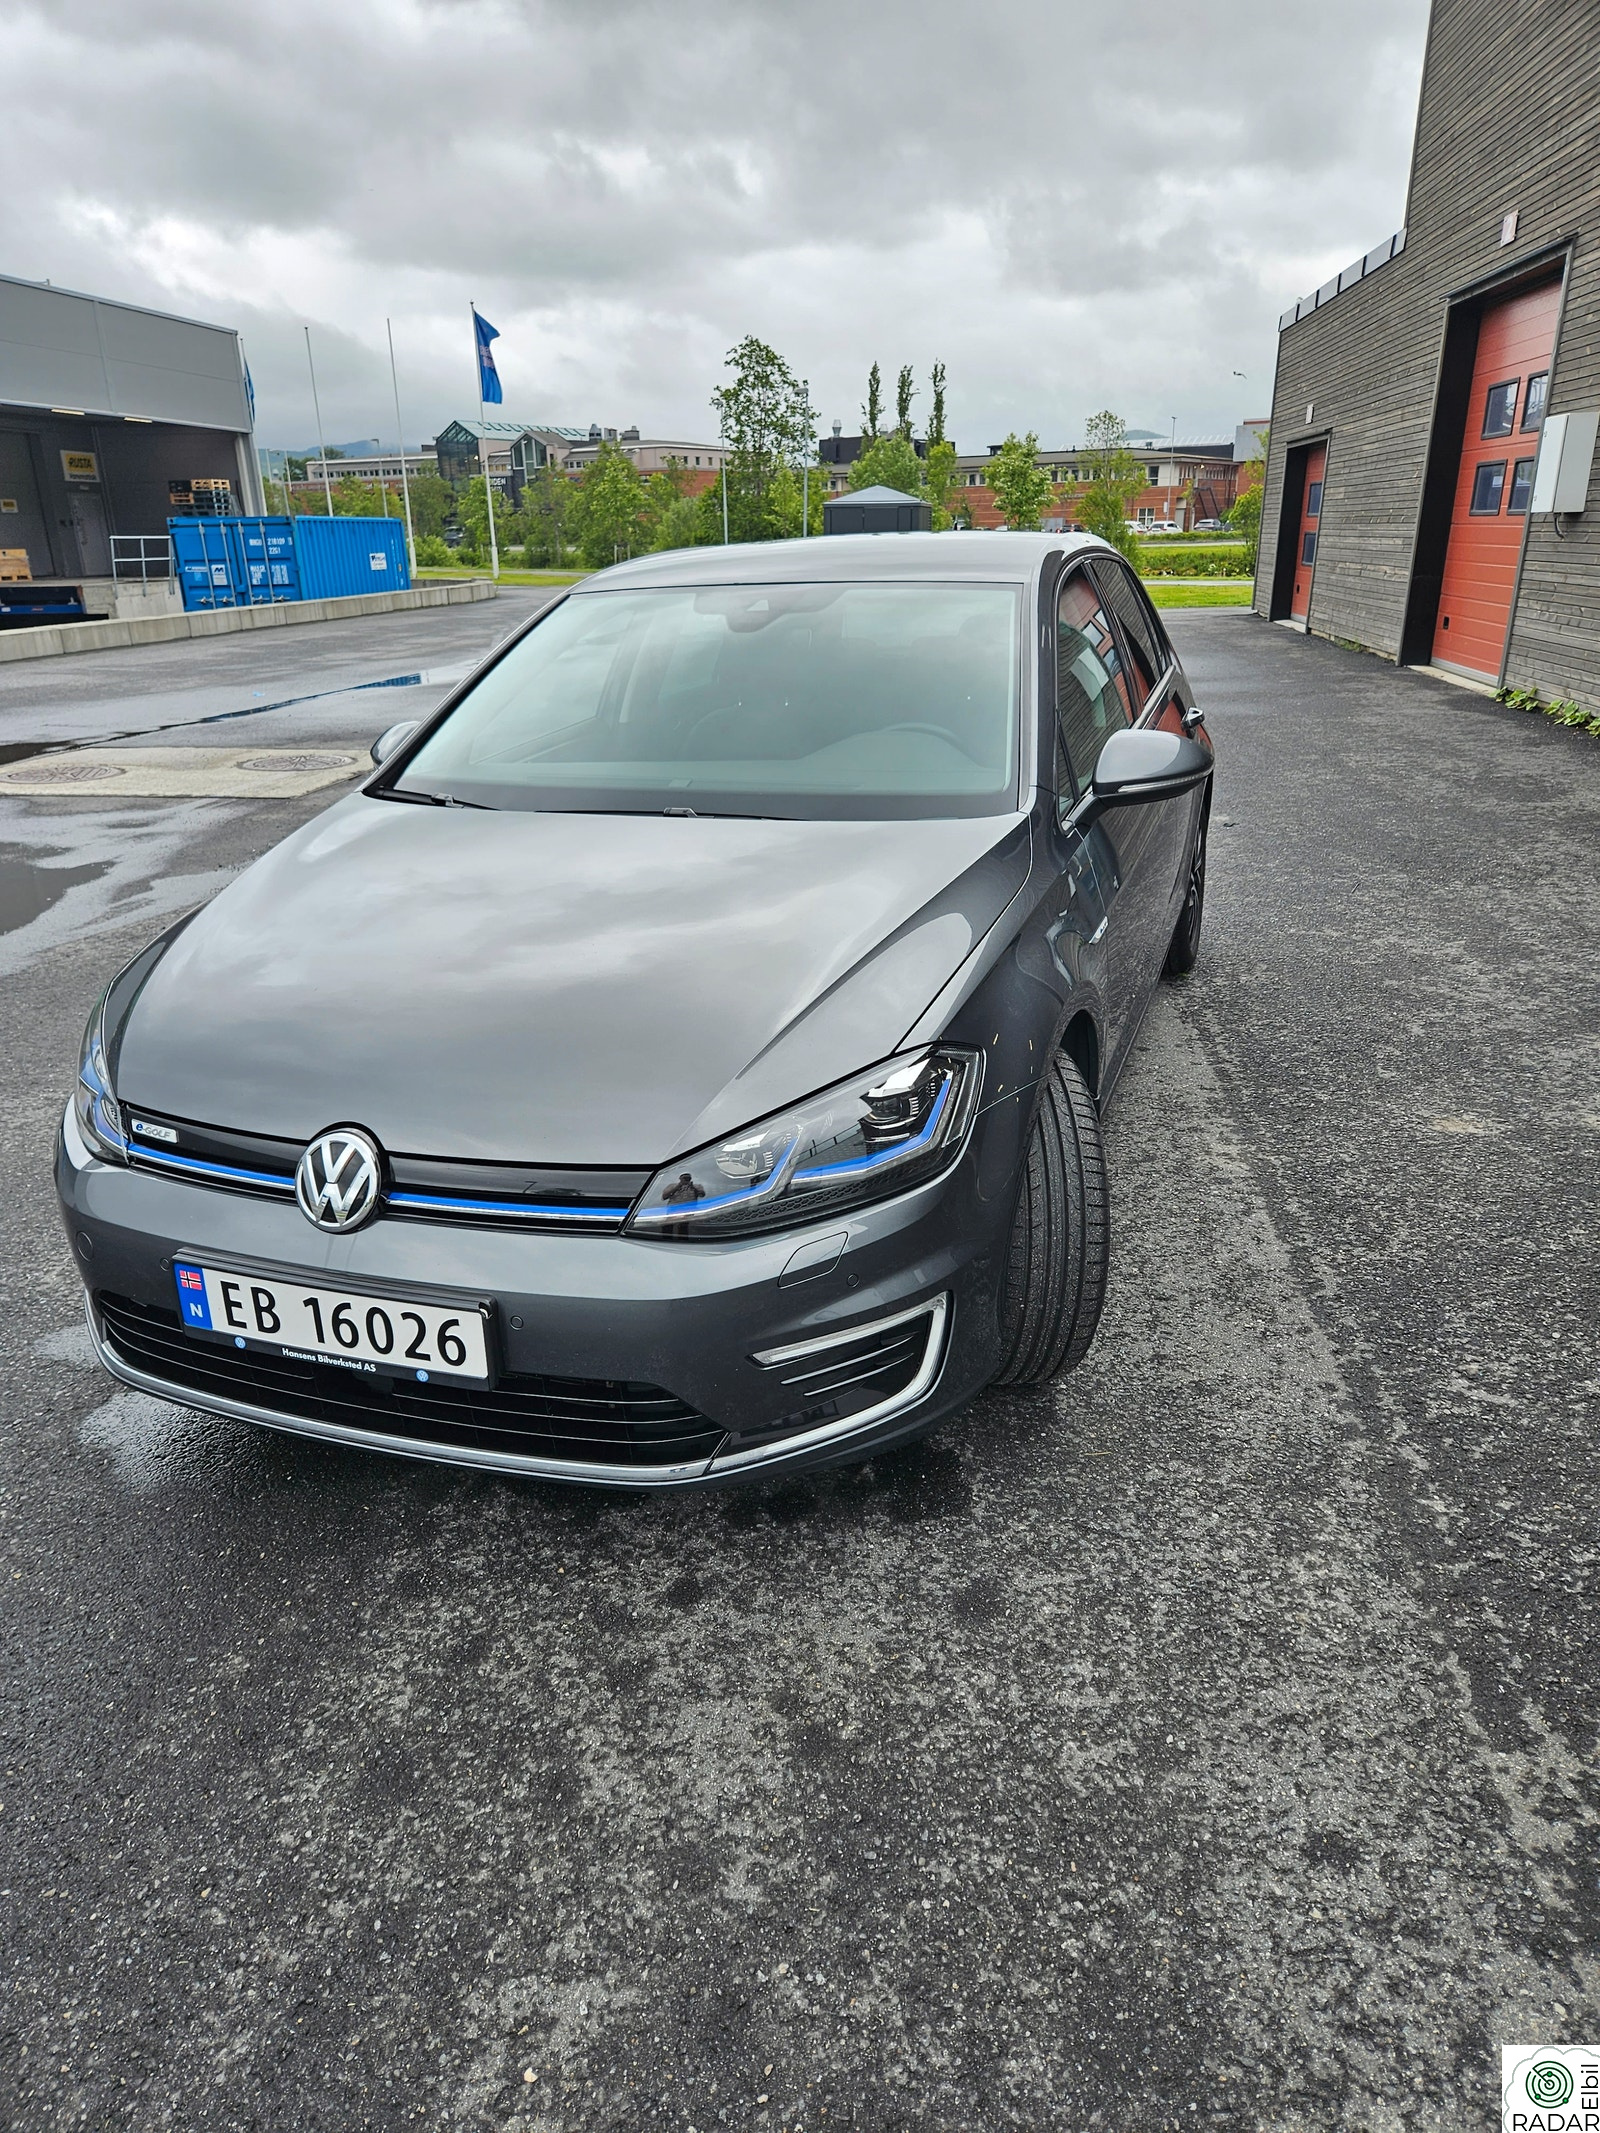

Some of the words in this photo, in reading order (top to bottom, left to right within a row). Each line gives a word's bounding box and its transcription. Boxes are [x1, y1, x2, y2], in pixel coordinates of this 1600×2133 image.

[68, 456, 92, 469] RUSTA
[136, 1123, 170, 1138] e-GOLF
[190, 1302, 203, 1318] N
[220, 1280, 281, 1334] EB
[303, 1296, 467, 1367] 16026
[282, 1347, 316, 1362] Hansens
[318, 1354, 362, 1371] Bilverksted
[363, 1363, 377, 1373] AS
